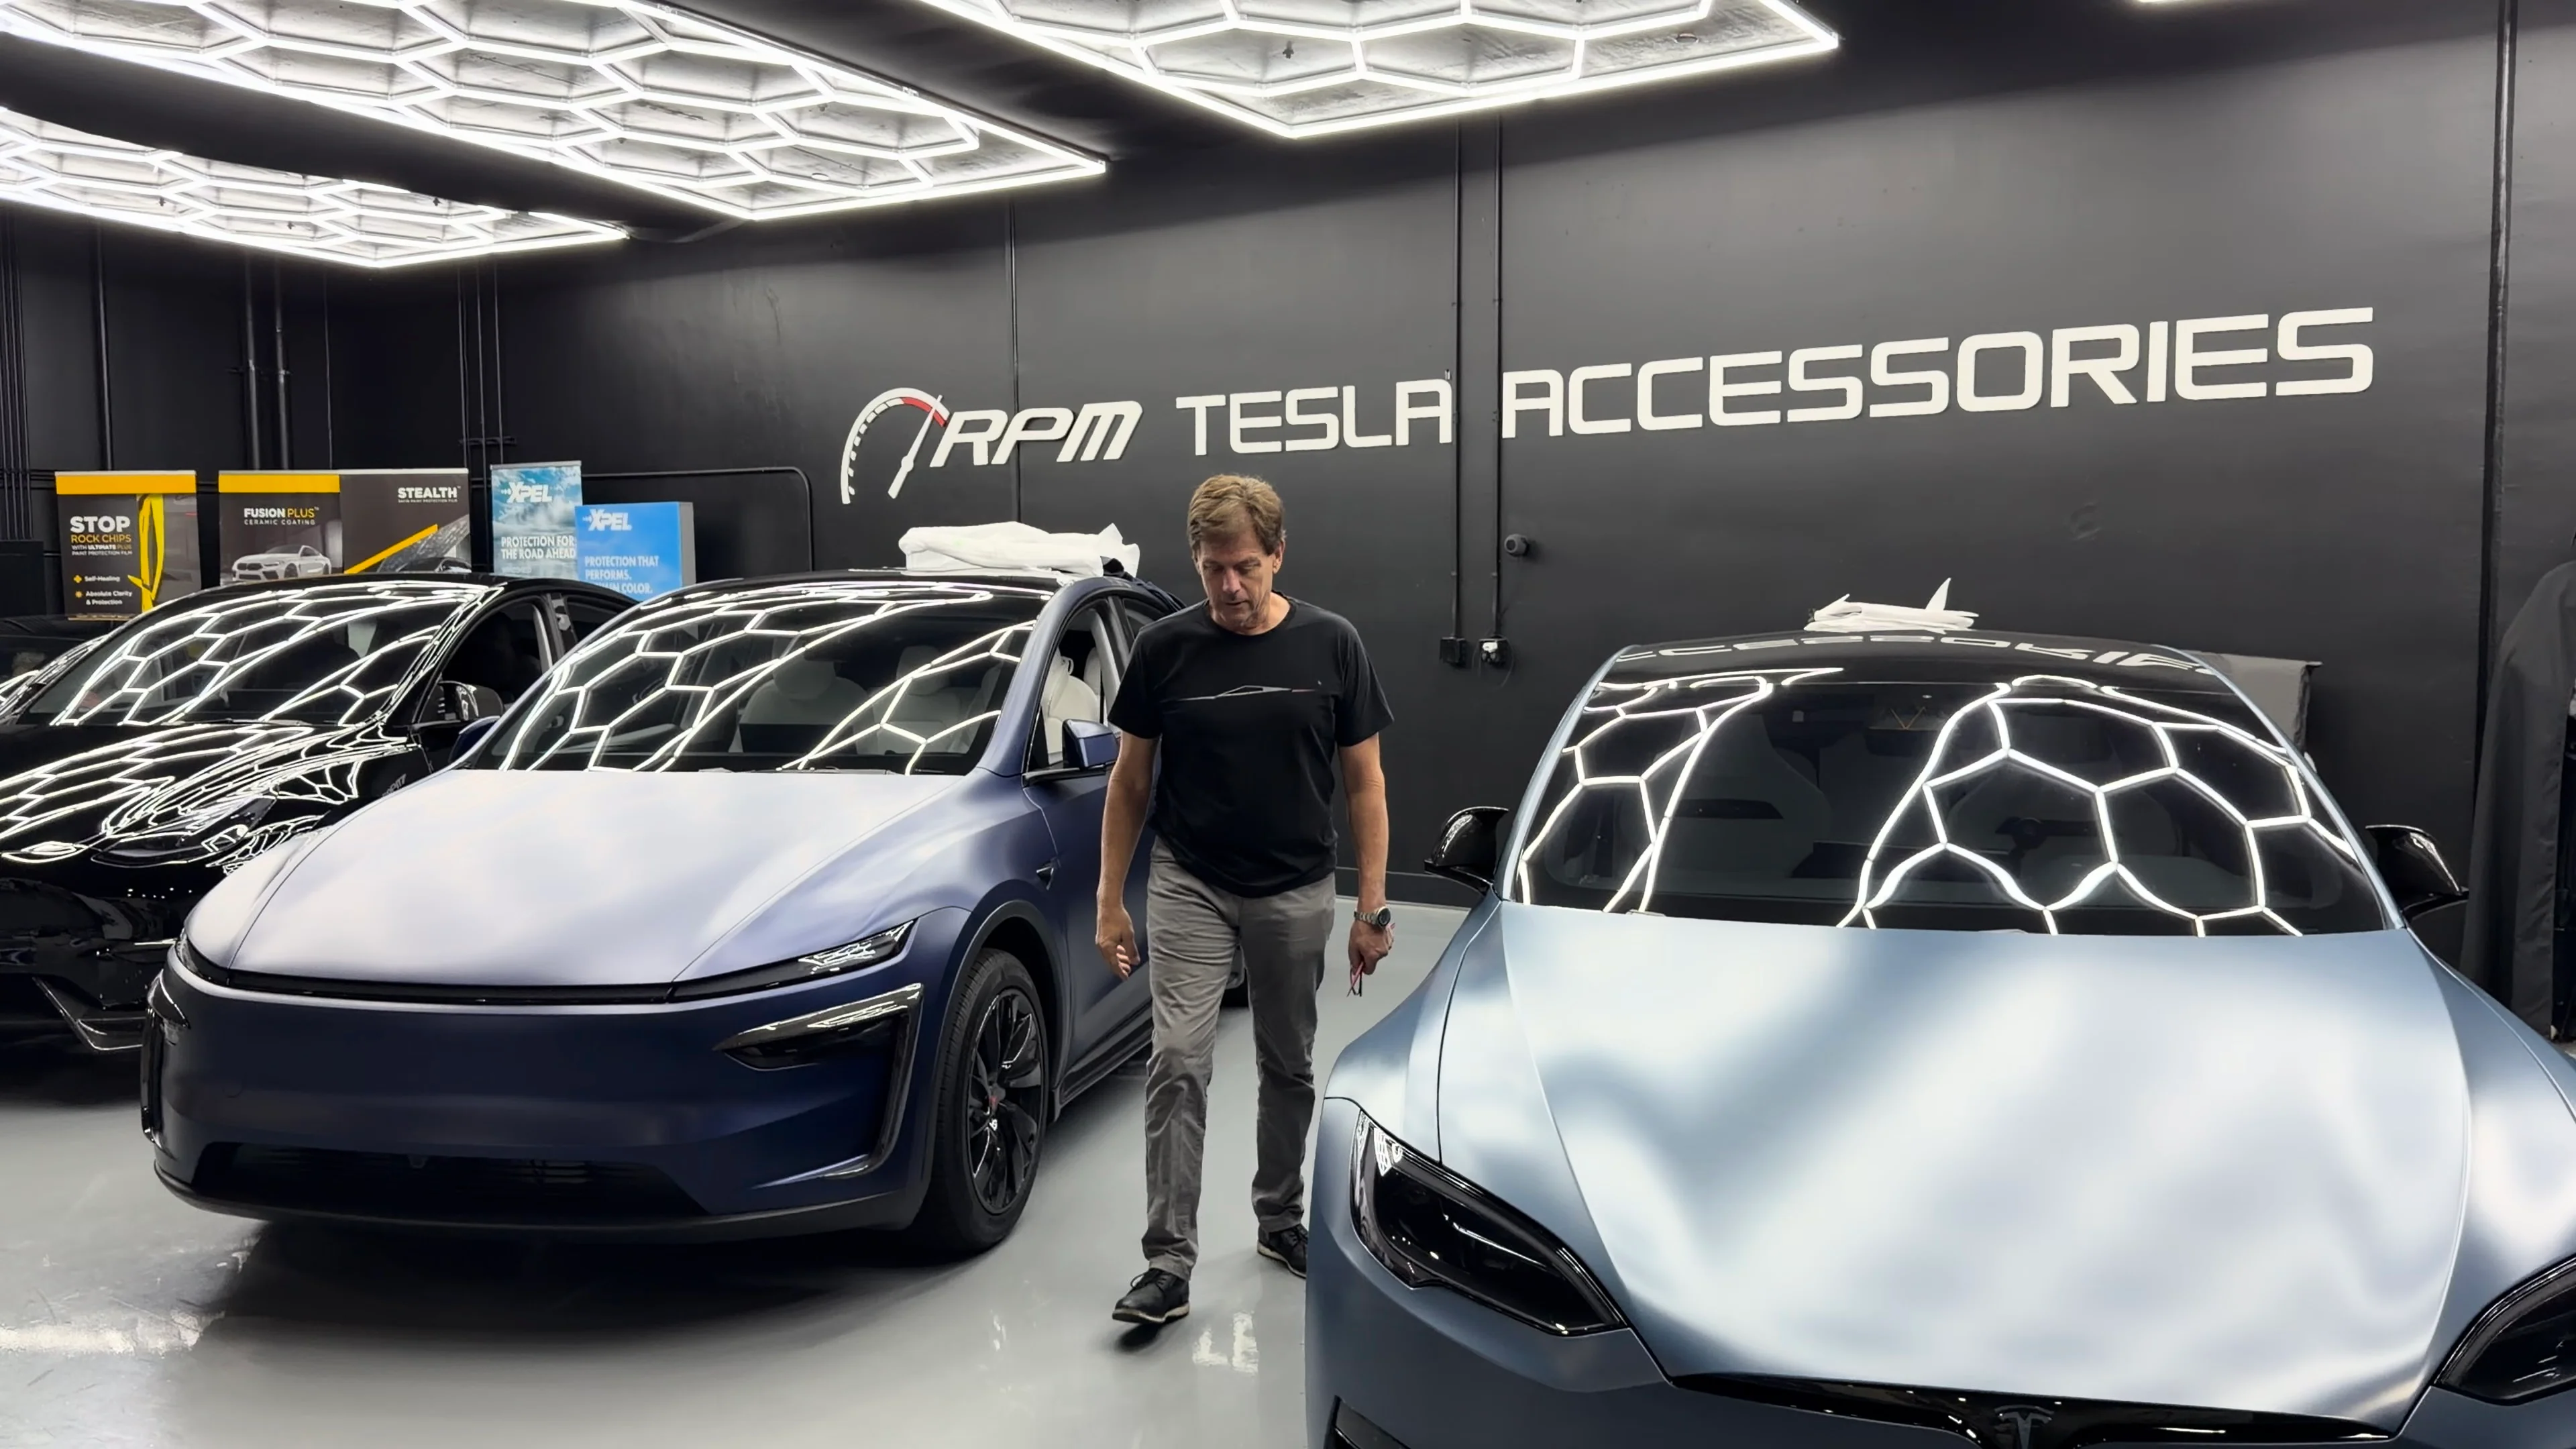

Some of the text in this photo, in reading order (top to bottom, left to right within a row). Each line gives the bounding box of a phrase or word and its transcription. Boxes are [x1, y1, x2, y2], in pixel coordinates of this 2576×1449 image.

[930, 307, 2374, 468] RPM TESLA ACCESSORIES
[506, 482, 552, 503] XPEL
[244, 508, 286, 518] FUSION
[70, 515, 131, 533] STOP
[588, 508, 632, 531] XPEL
[70, 534, 131, 543] ROCK CHIPS
[501, 535, 576, 547] PROTECTION FOR
[500, 547, 577, 559] THE ROAD AHEAD
[584, 555, 659, 567] PROTECTION THAT
[585, 569, 632, 580] PERFORMS.
